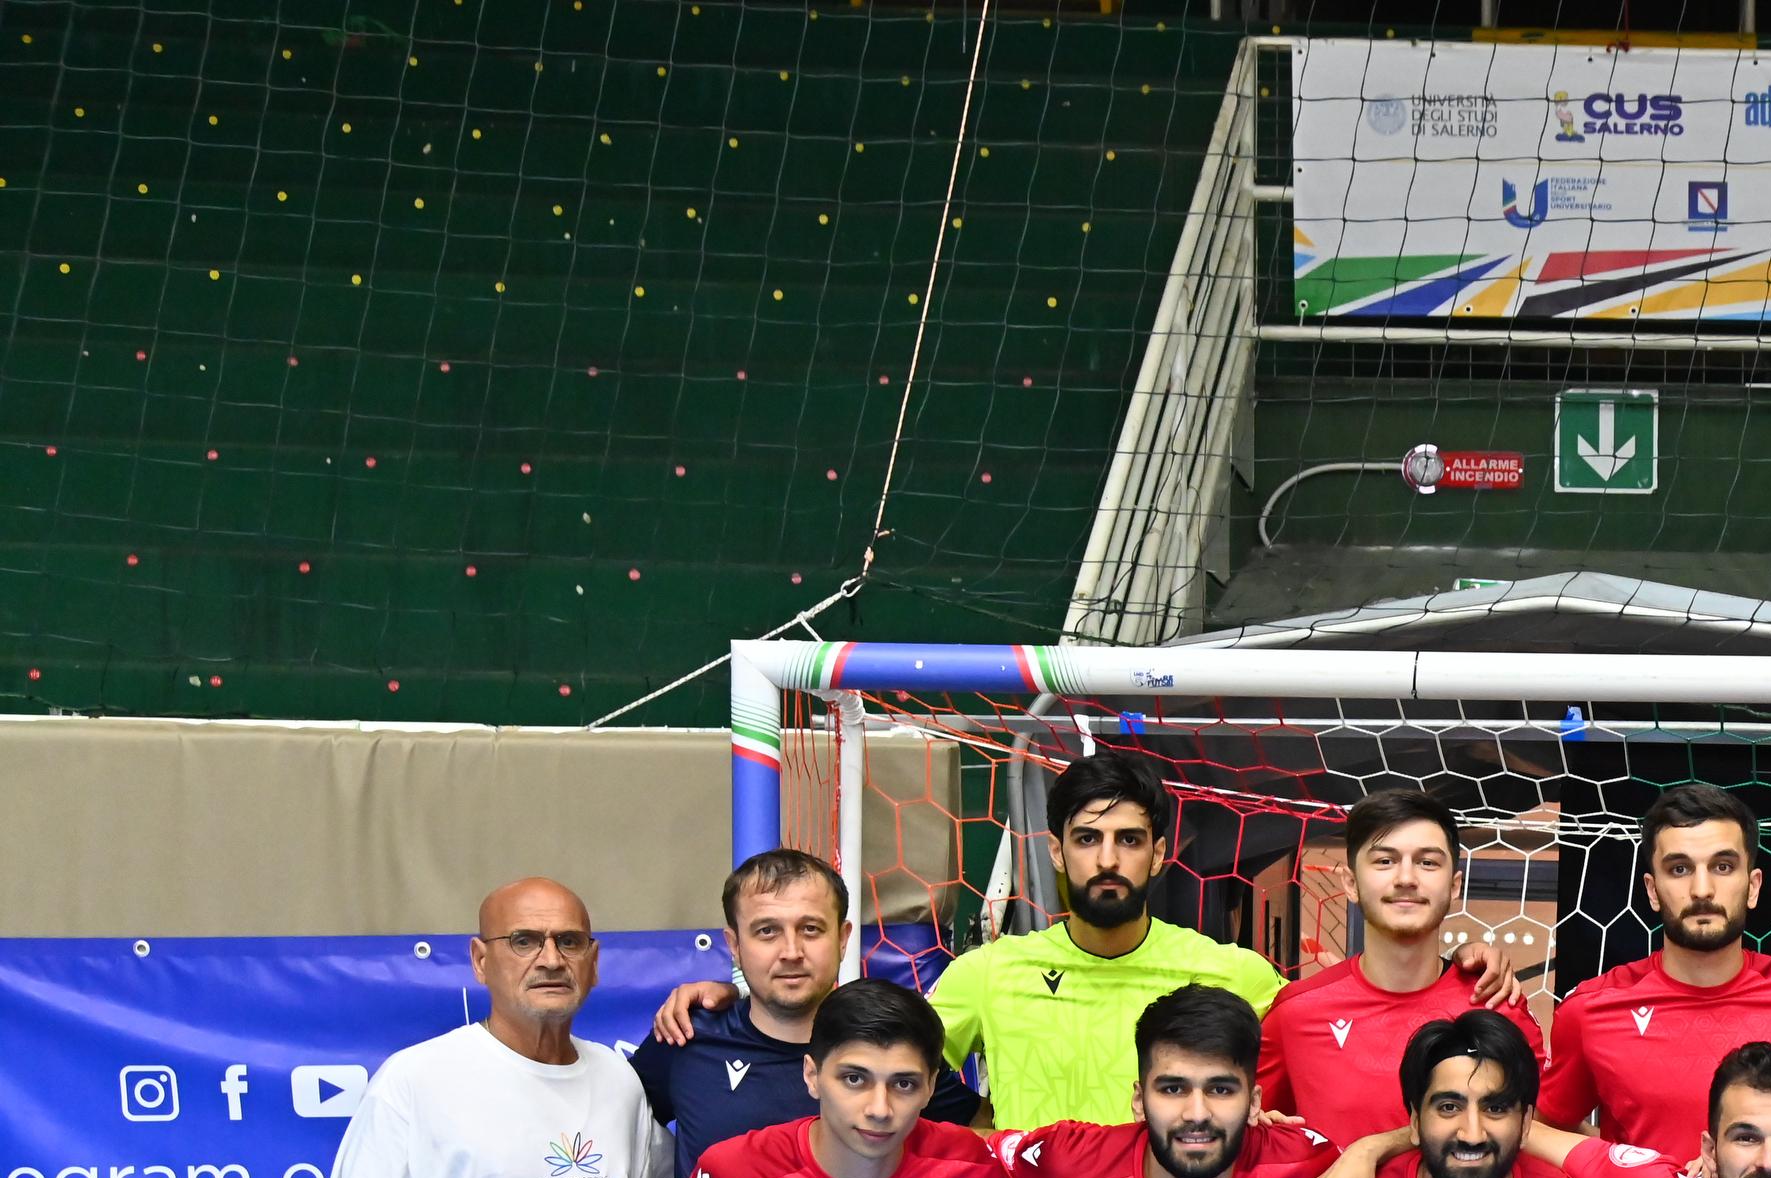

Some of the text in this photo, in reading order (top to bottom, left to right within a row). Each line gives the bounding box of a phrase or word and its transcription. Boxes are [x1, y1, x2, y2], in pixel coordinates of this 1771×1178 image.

[1583, 92, 1683, 121] CUS
[1411, 109, 1498, 123] DEGLI STUDI
[1411, 123, 1498, 138] DI SALERNO
[1583, 122, 1684, 136] SALERNO
[1452, 458, 1519, 470] ALLARME
[1450, 470, 1519, 482] INCENDIO
